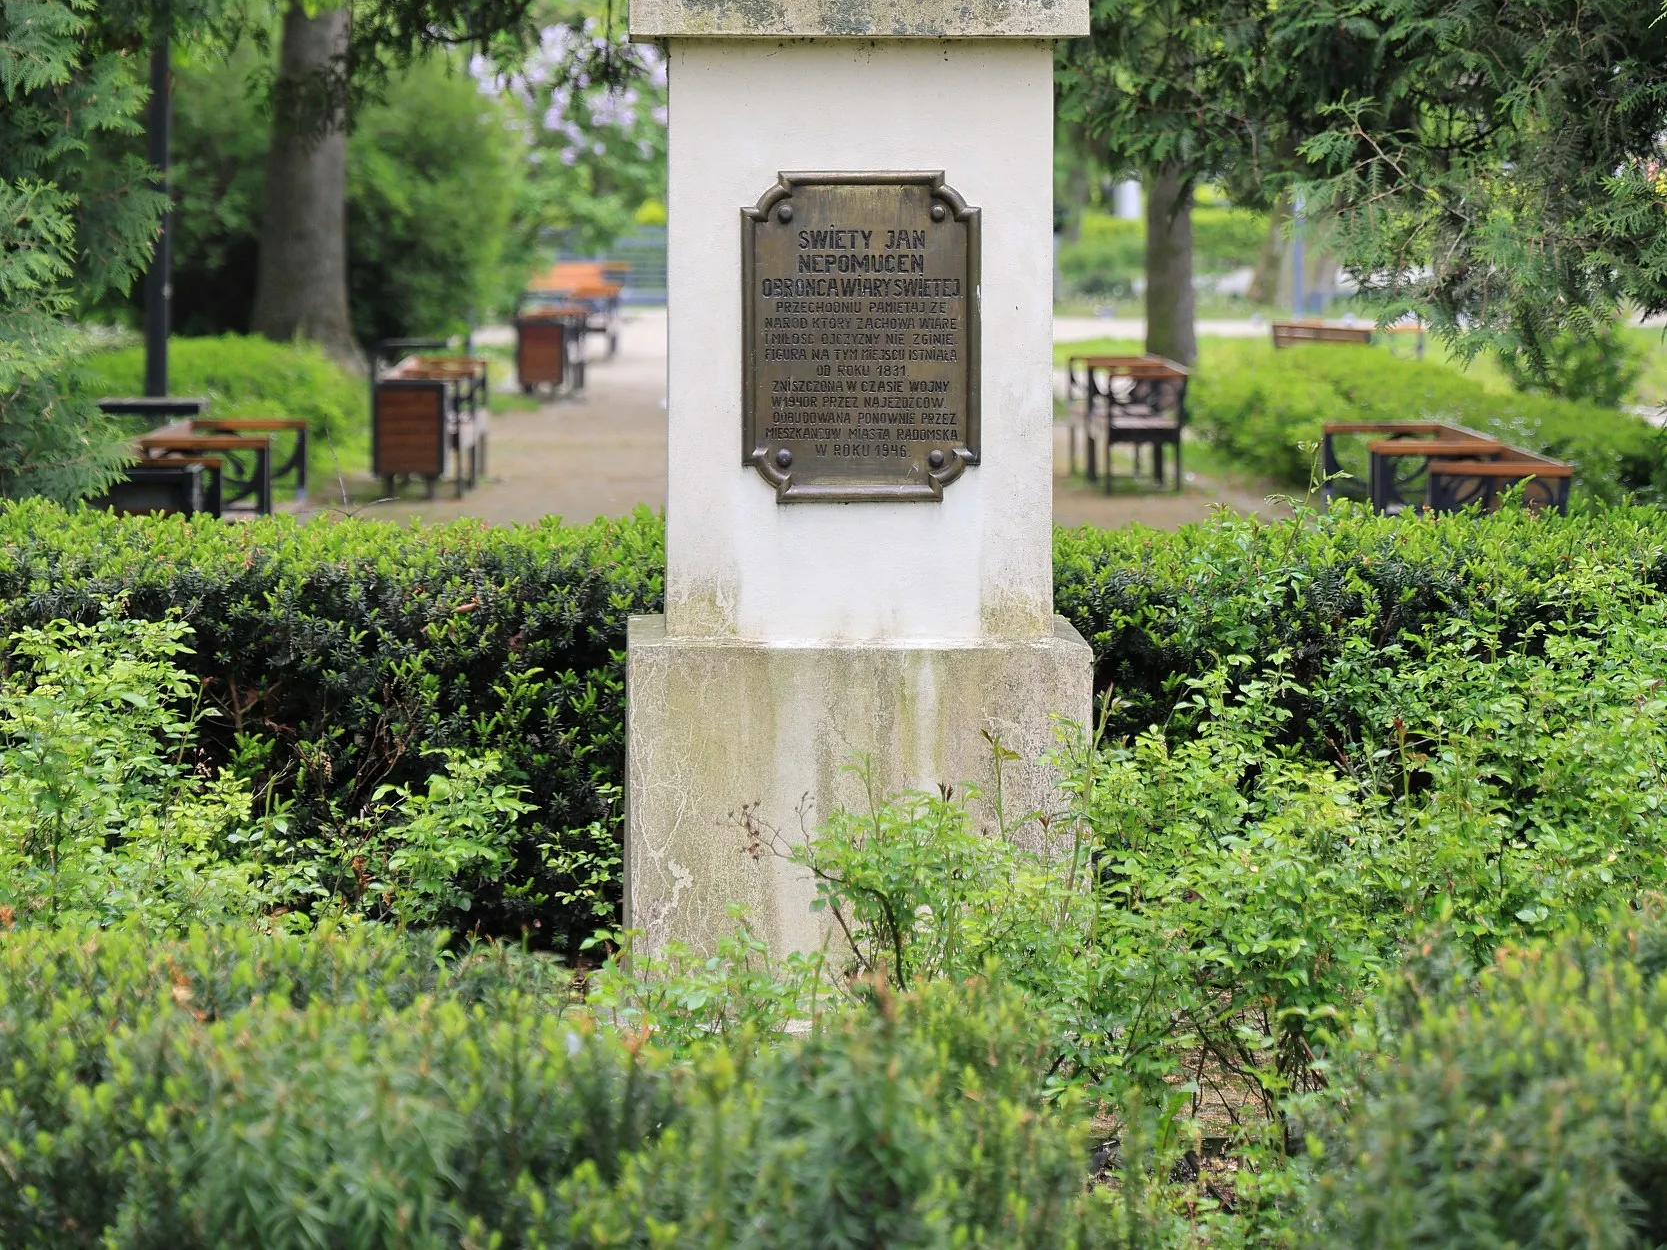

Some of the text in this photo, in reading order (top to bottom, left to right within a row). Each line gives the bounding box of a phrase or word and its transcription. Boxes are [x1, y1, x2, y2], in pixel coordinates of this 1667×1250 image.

[884, 230, 926, 250] JAN
[797, 255, 924, 274] NEPOMUCEN
[840, 275, 890, 298] WIARY
[775, 299, 862, 314] PRZECHODNIU
[856, 317, 916, 330] ZACHOWA
[765, 330, 769, 345] I
[821, 333, 880, 345] OJCZYZNY
[885, 330, 905, 345] NIE
[765, 346, 807, 361] FIGURA
[812, 348, 829, 361] NA
[834, 348, 858, 361] TYM
[861, 346, 905, 361] MIEJSCU
[816, 365, 831, 376] OD
[837, 364, 871, 377] ROKU
[772, 377, 950, 393] ZNISZCZONA W CZASIE WOJNY
[822, 397, 859, 409] PRZEZ
[772, 410, 957, 425] ODBUDOWANA PONOWNIE PRZEZ
[848, 425, 891, 441] MIASTA
[896, 429, 958, 441] RADOMSKA
[815, 444, 828, 457] W
[833, 444, 870, 458] ROKU
